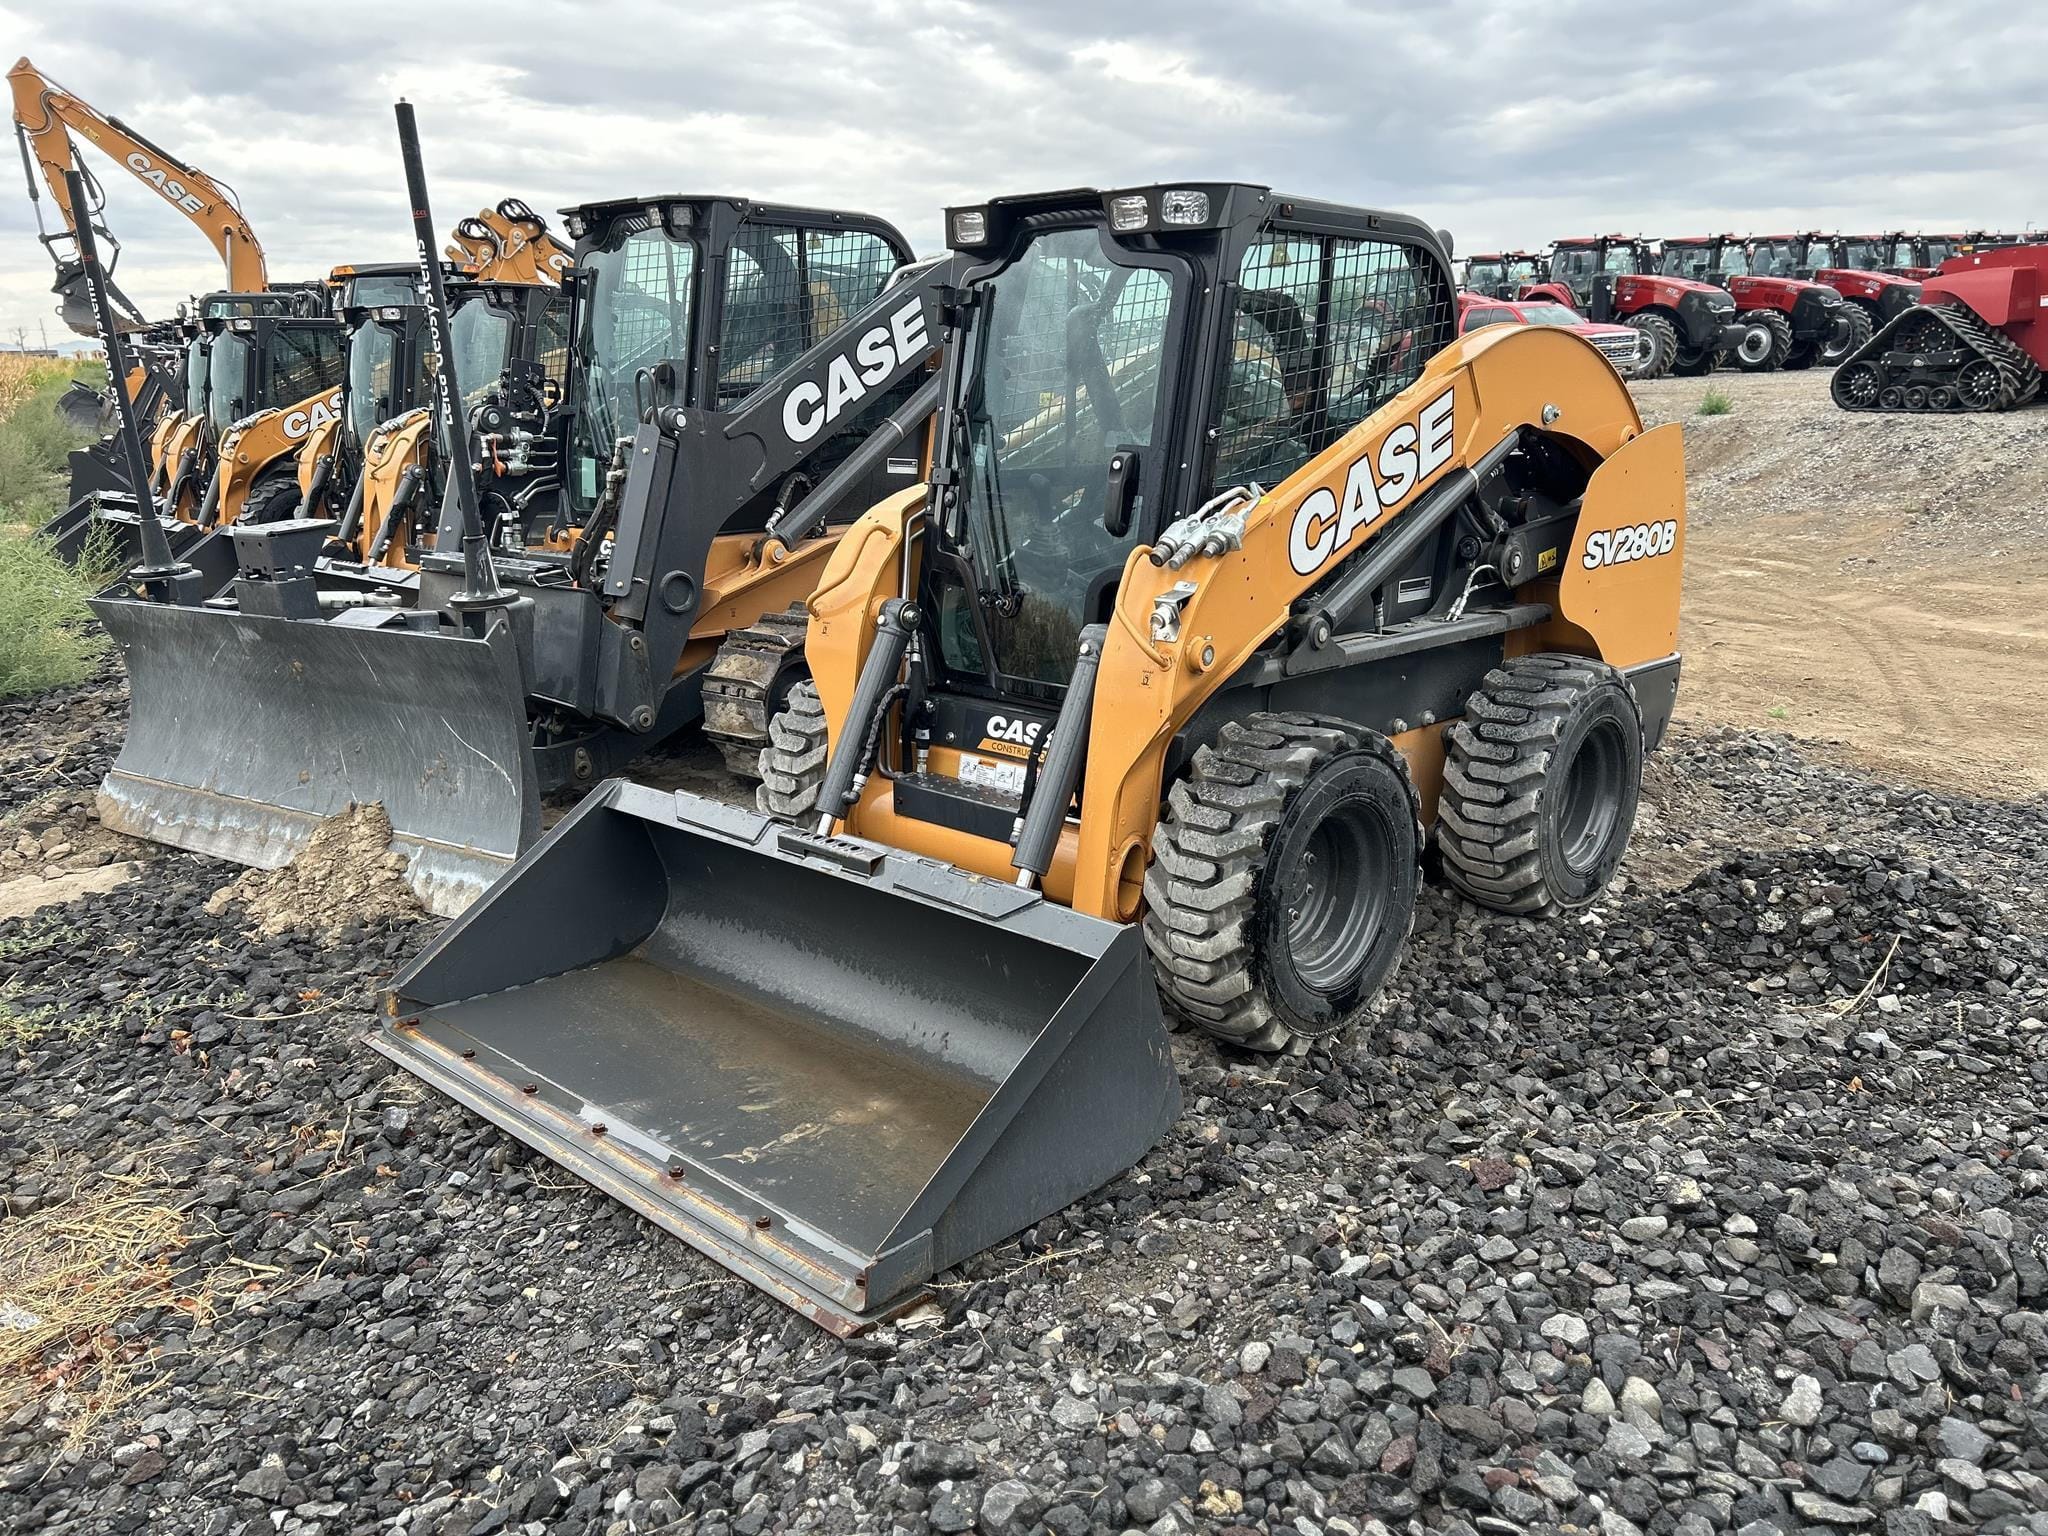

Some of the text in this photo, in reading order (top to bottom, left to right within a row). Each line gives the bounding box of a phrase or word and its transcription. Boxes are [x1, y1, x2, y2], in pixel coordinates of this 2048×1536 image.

[125, 152, 206, 214] CASE
[783, 295, 929, 443] CASE
[283, 391, 343, 438] CAS
[1288, 385, 1455, 576] CASE
[1582, 519, 1677, 570] SV280B
[986, 715, 1055, 748] CAS
